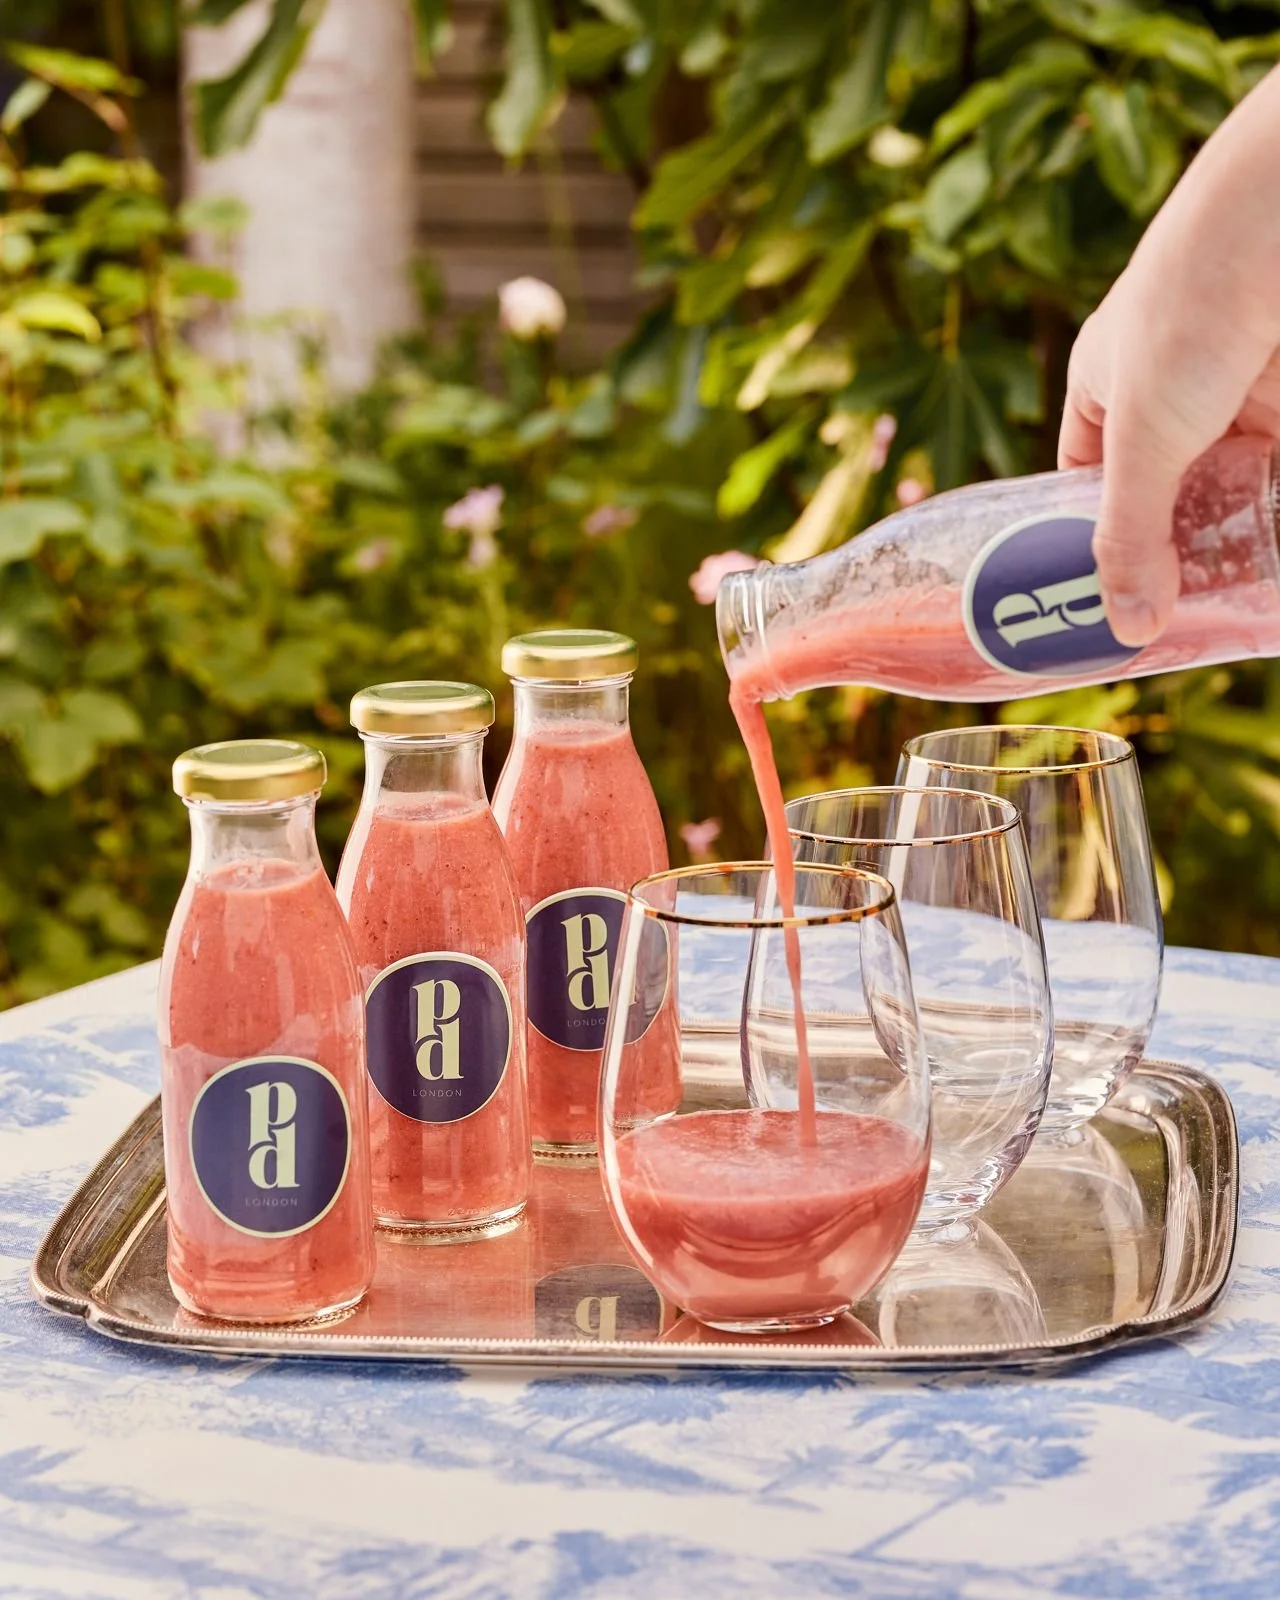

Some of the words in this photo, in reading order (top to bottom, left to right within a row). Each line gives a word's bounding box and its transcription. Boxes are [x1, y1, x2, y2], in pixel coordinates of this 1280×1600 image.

[567, 1017, 606, 1028] LONDO
[412, 1089, 463, 1098] LONDON
[245, 1198, 298, 1207] LONDON
